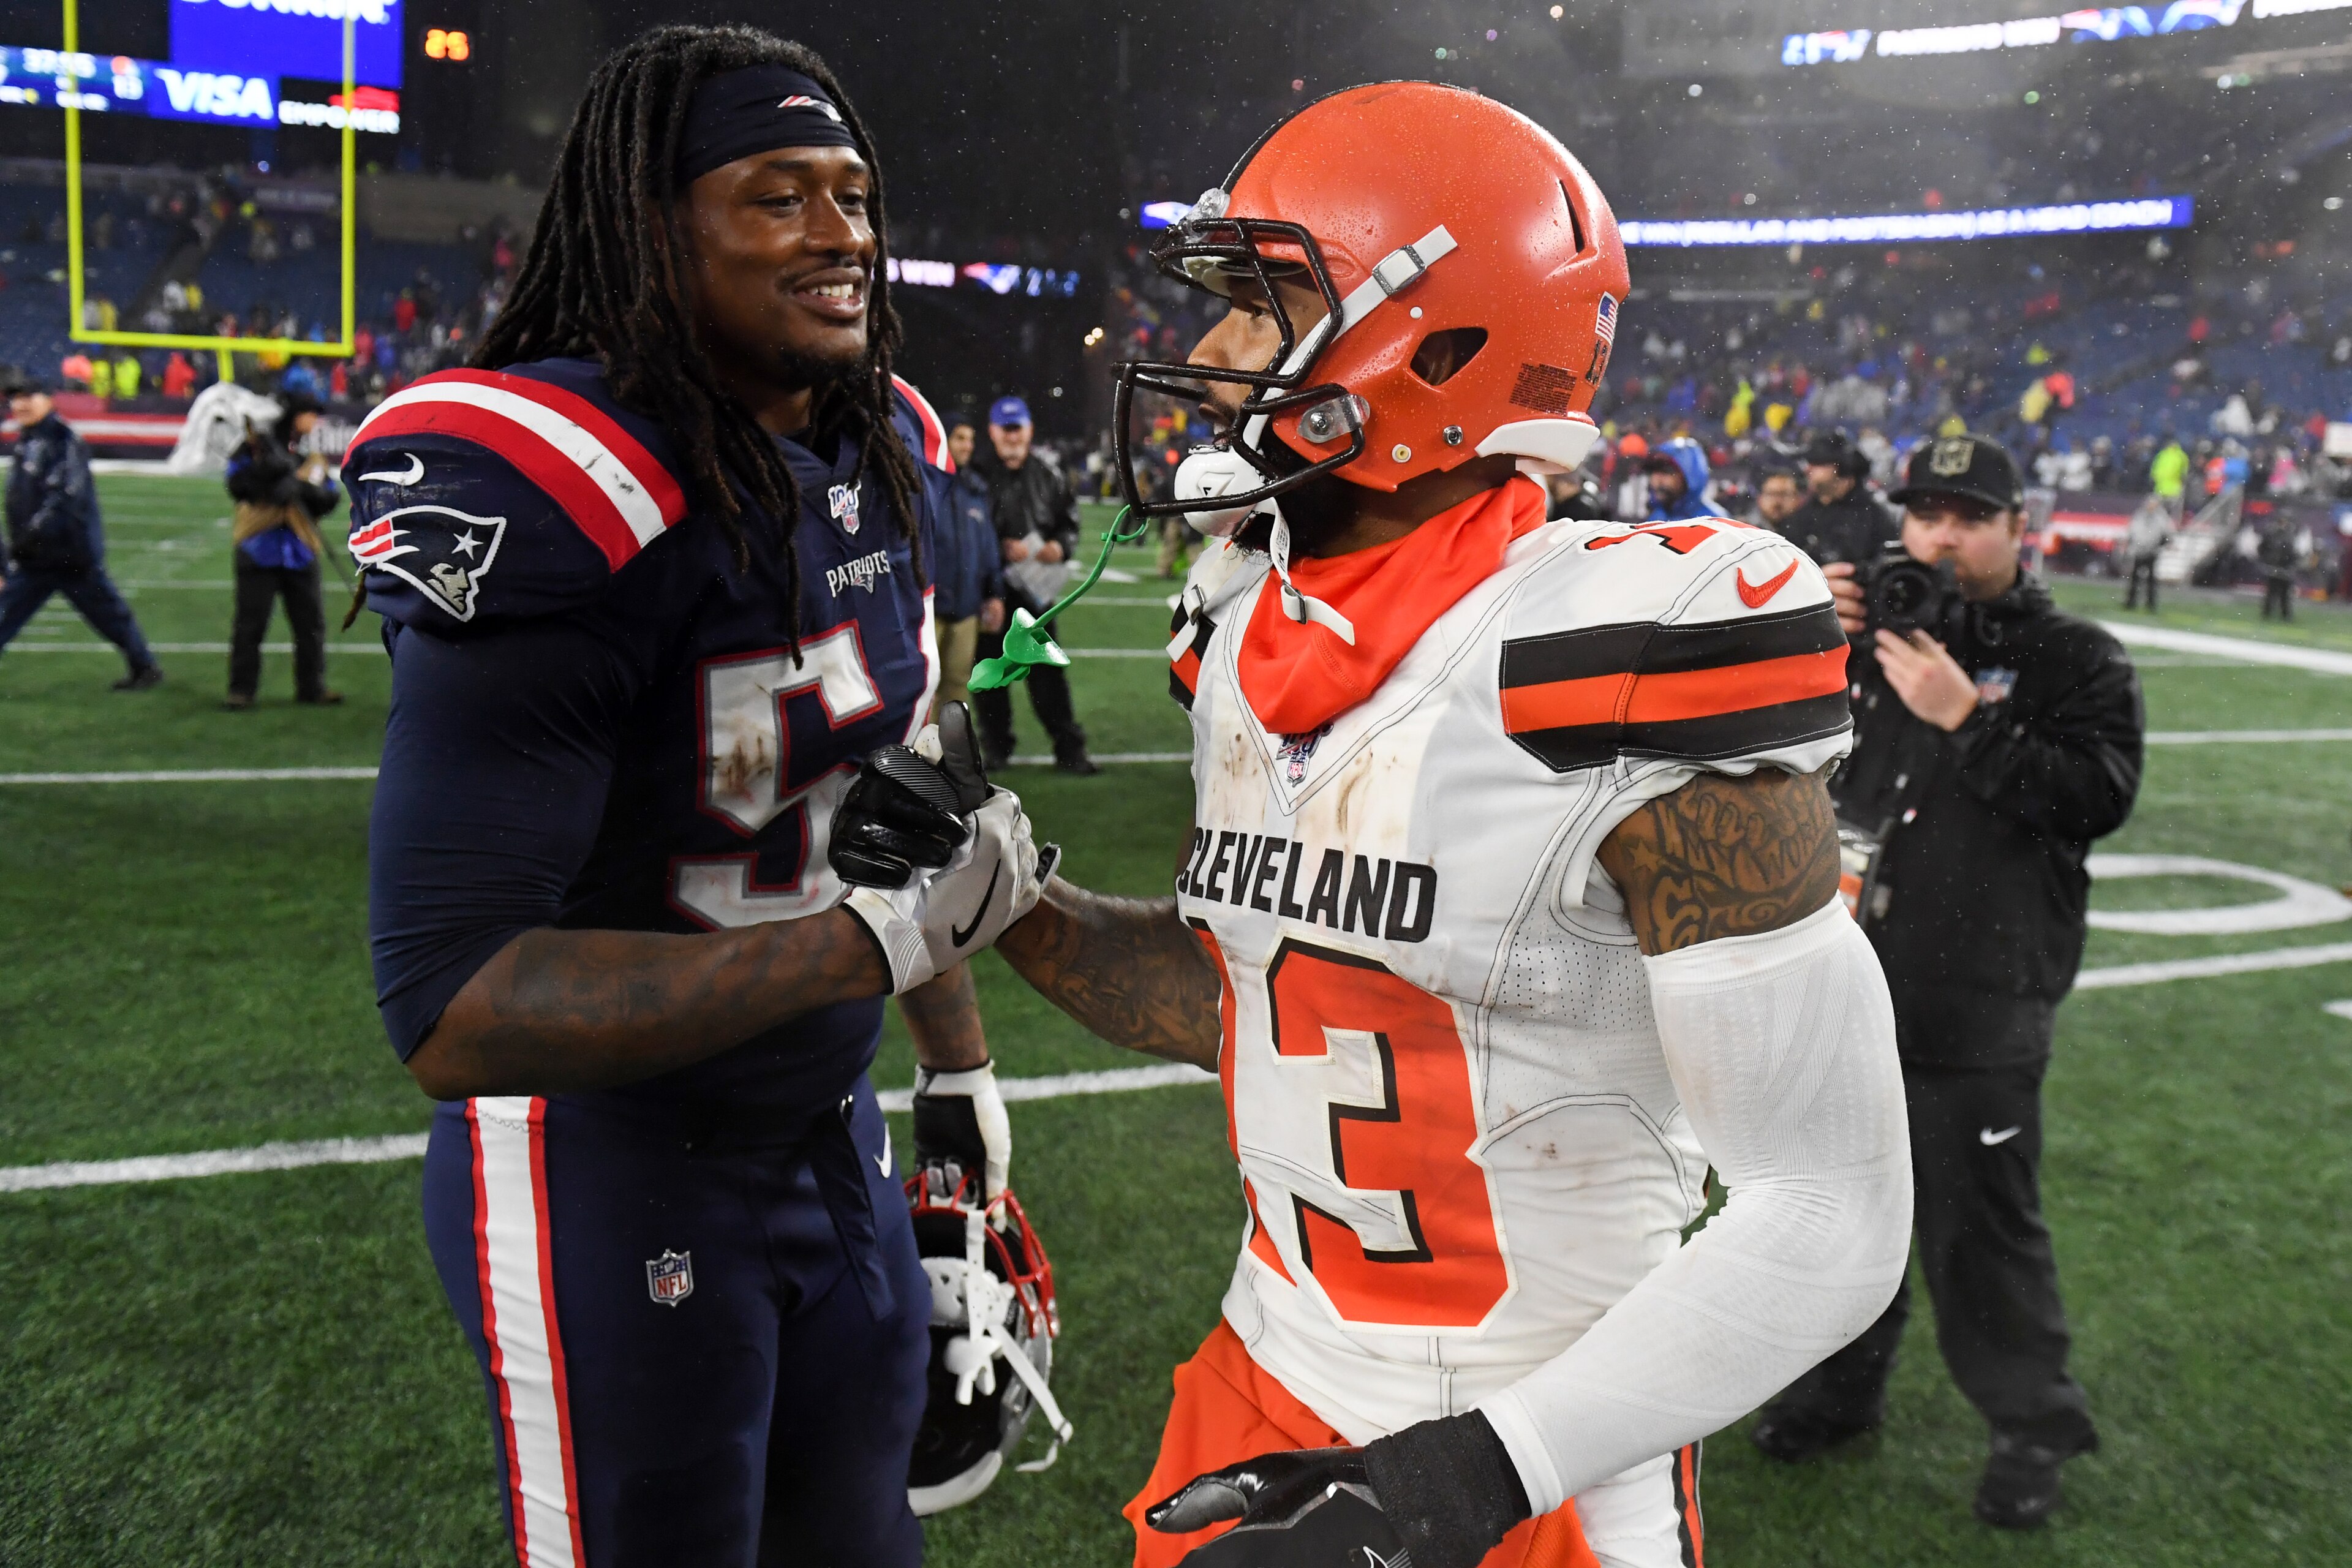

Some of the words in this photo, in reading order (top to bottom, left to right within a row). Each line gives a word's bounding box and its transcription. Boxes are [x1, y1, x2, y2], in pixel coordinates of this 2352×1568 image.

[155, 69, 273, 119] VISA
[826, 550, 891, 598] PATRIOTS
[1178, 827, 1437, 942] CLEVELAND
[656, 1273, 687, 1297] NFL
